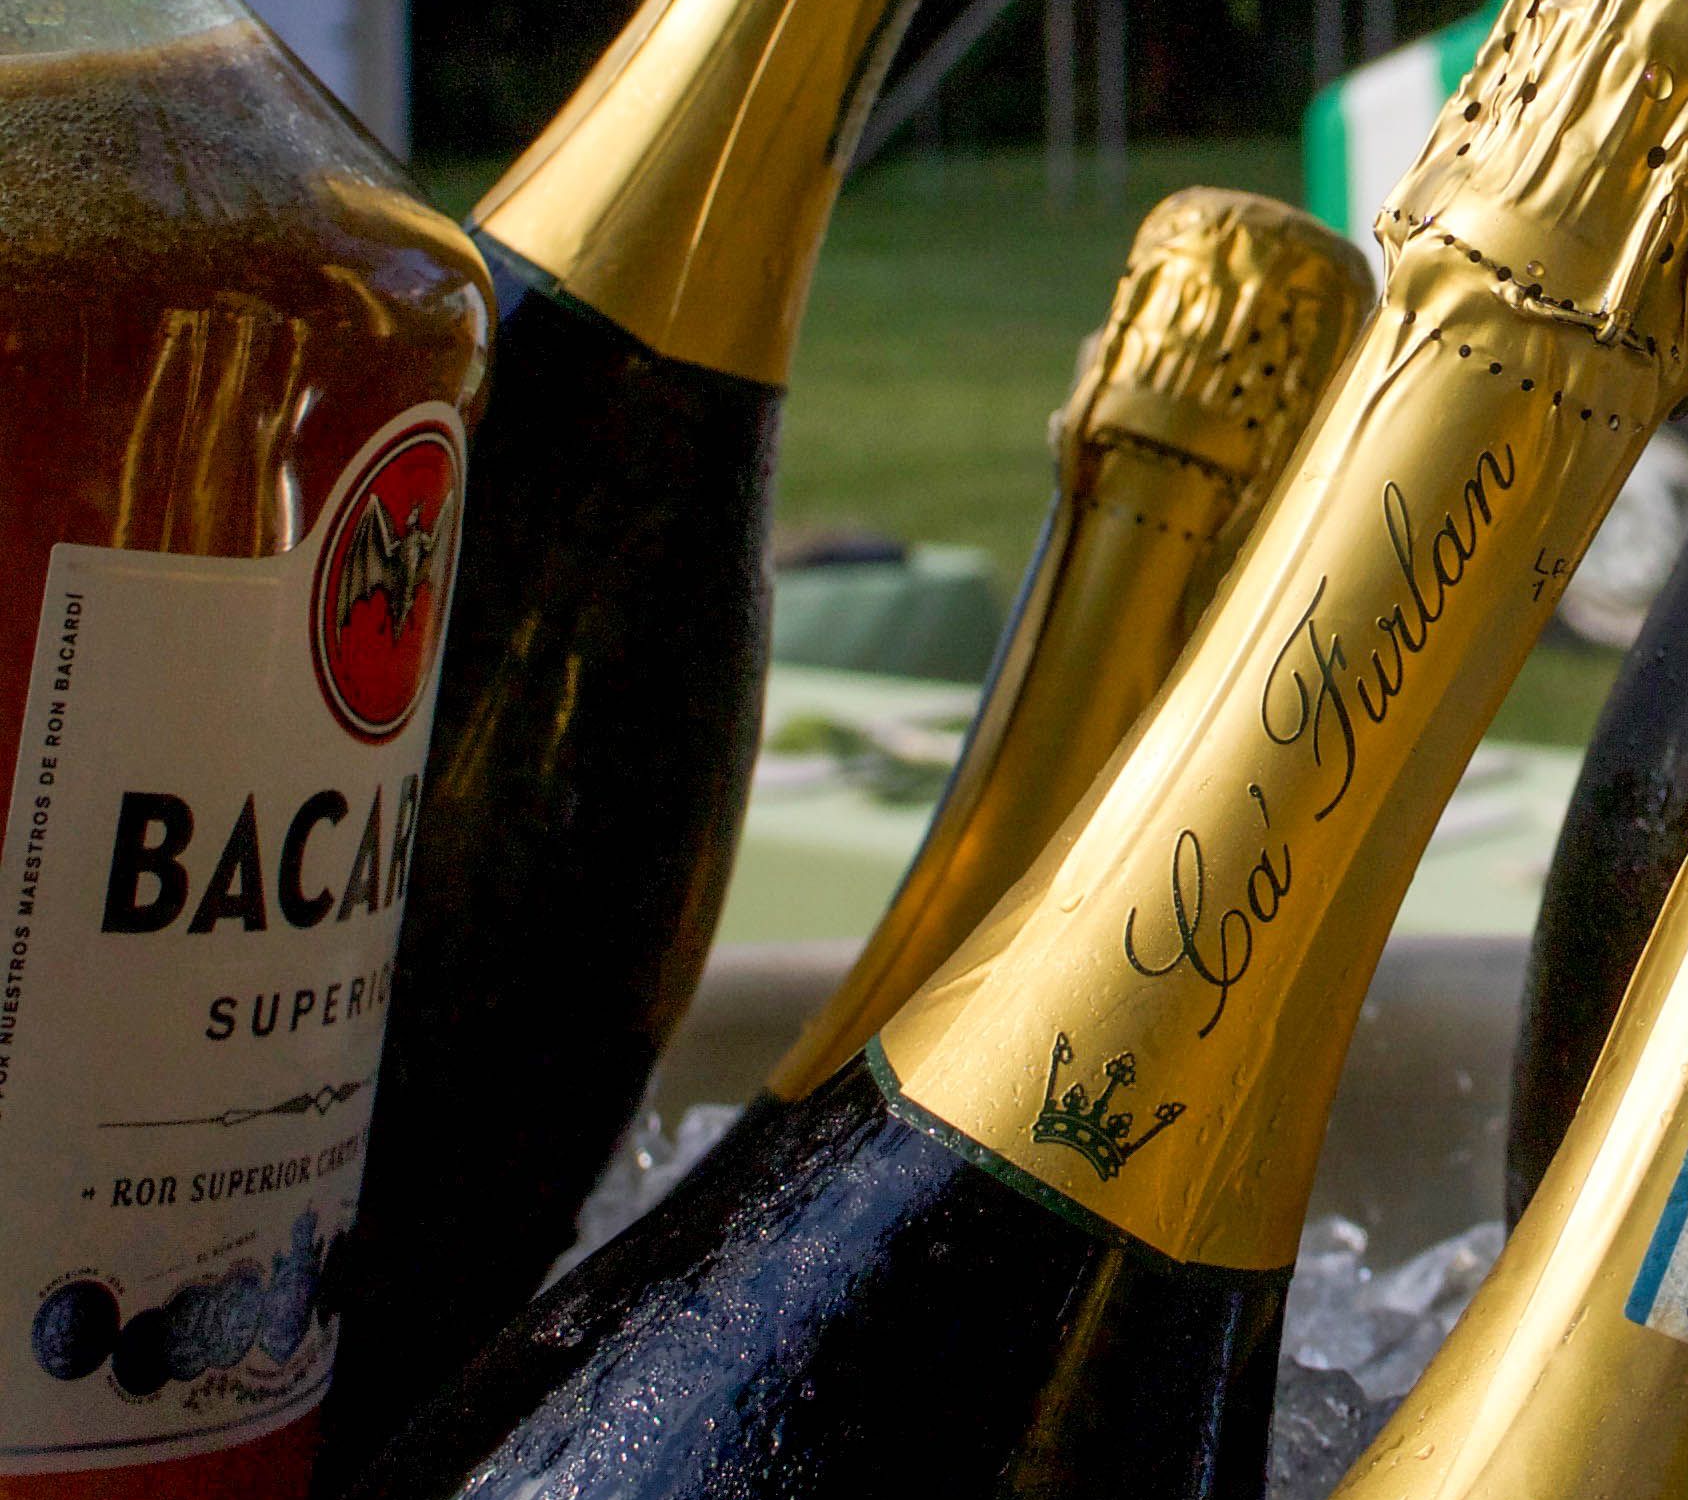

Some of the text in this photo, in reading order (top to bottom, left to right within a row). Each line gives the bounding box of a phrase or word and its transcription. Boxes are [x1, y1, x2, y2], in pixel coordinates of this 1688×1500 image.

[1259, 441, 1517, 822] Furlan
[45, 701, 66, 747] RON
[39, 757, 57, 785] DE
[18, 795, 51, 916] MAESTROS
[0, 925, 31, 1046] NUESTROS
[191, 1154, 312, 1203] SUPERIOR
